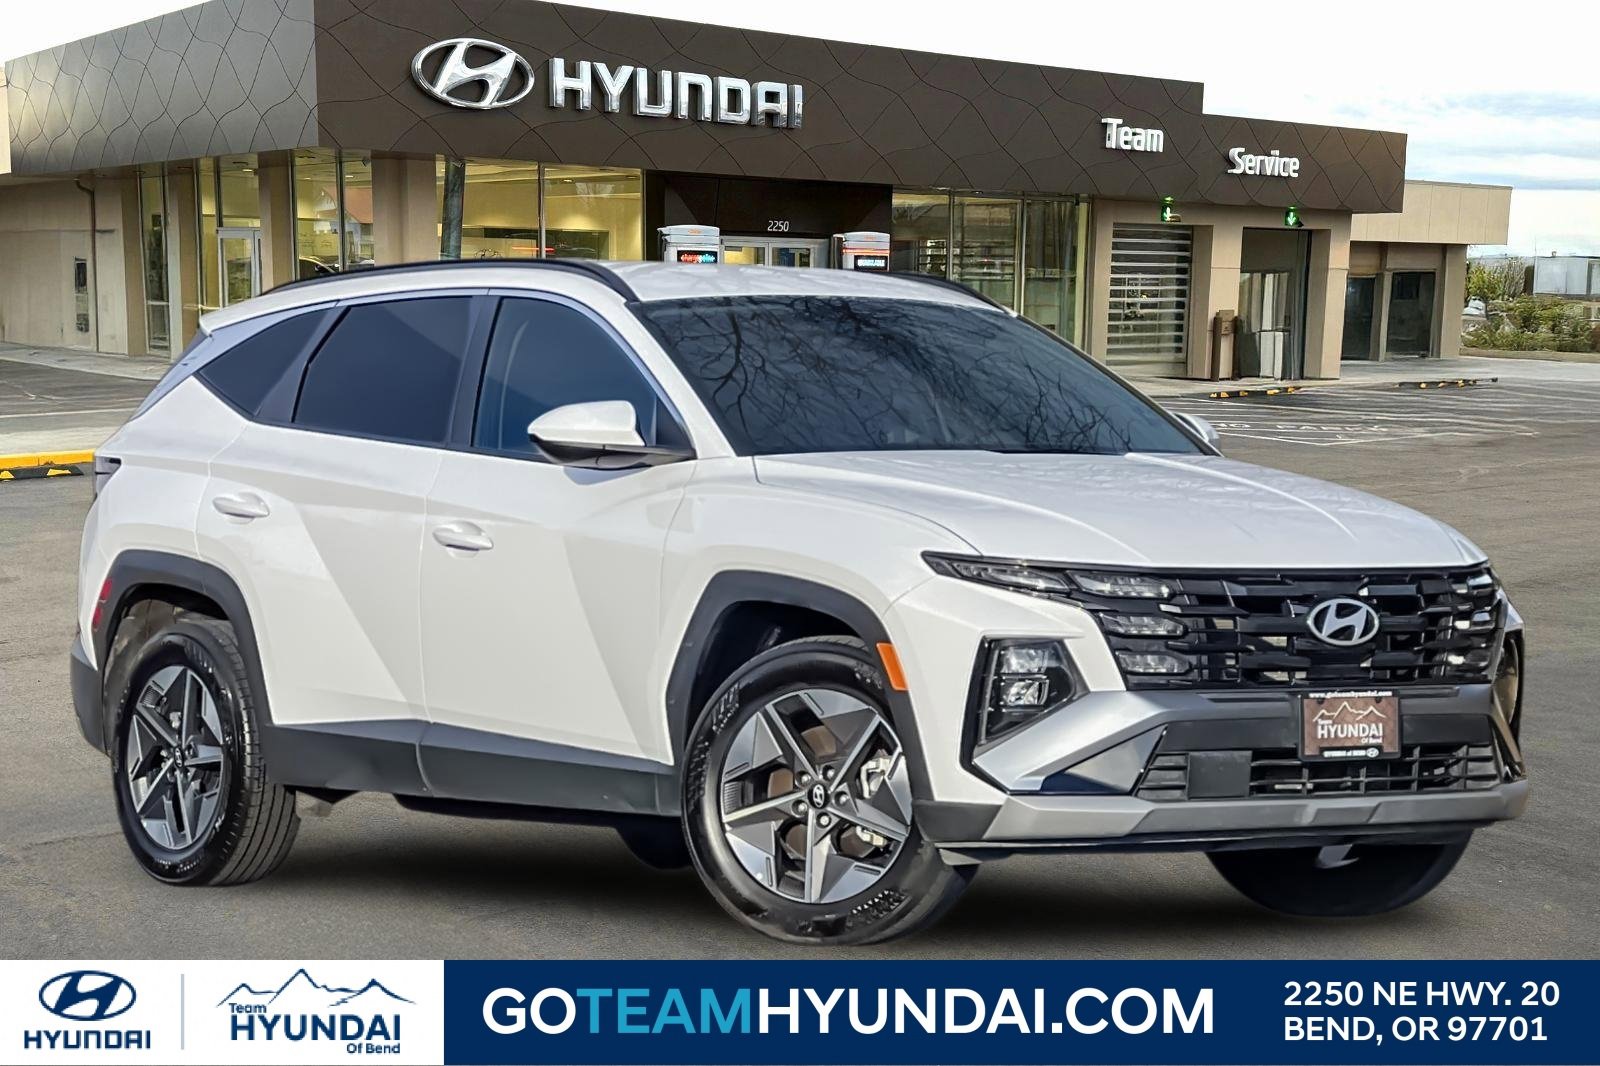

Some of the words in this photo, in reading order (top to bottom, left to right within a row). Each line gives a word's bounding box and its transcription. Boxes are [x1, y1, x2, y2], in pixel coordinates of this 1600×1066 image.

[548, 57, 803, 129] HYUNDAI
[1101, 118, 1164, 152] Team
[1228, 147, 1300, 177] Service
[767, 220, 789, 232] 2250
[1317, 723, 1383, 739] HYUNDAI
